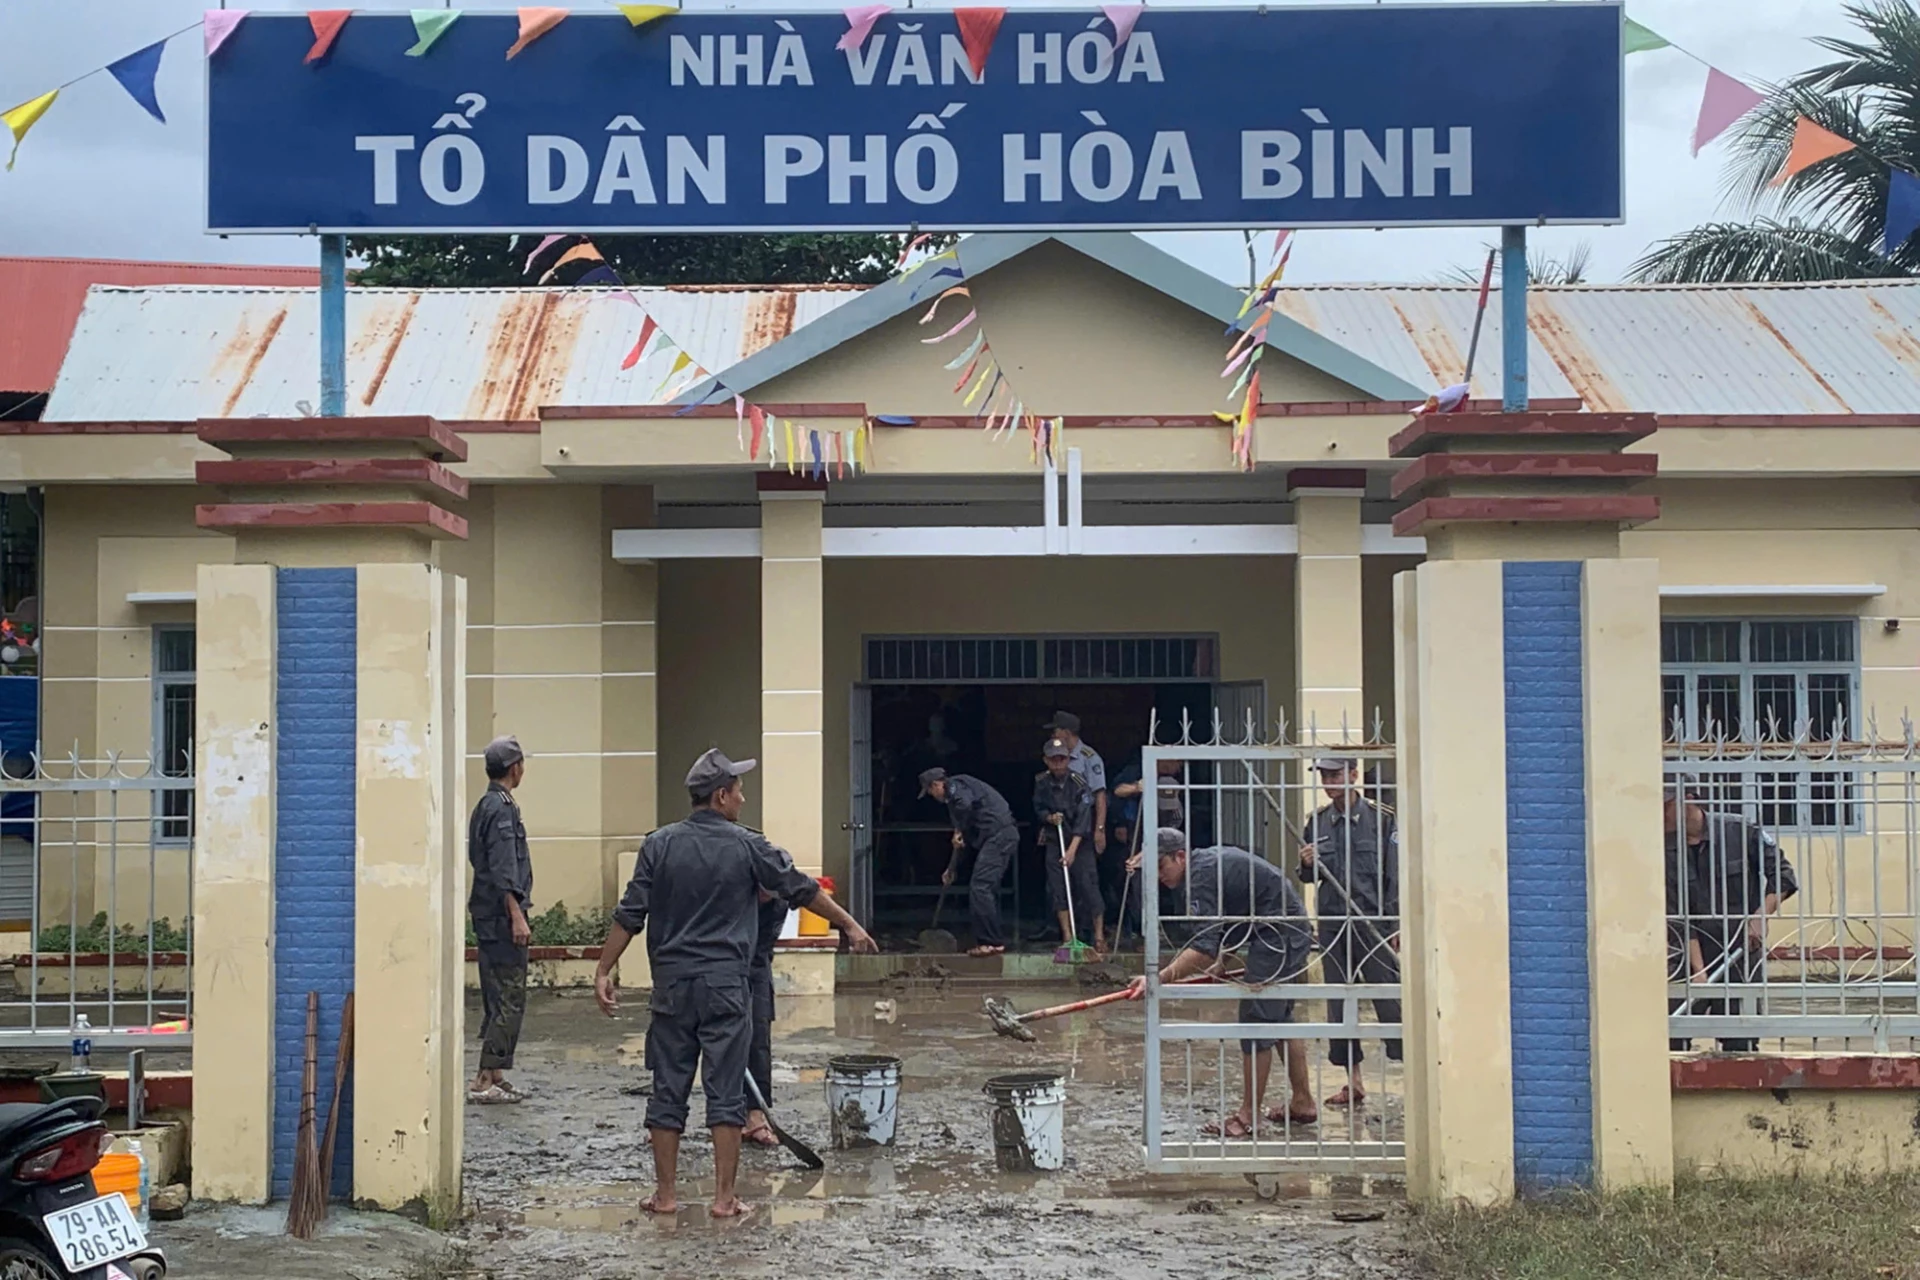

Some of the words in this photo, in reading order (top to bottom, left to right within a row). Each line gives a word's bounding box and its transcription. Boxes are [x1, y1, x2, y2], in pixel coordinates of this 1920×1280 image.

[670, 20, 814, 86] NHÀ
[1018, 17, 1165, 84] HÓA
[355, 92, 487, 205] TỔ
[527, 115, 726, 204] DÂN
[764, 103, 967, 204] PHỐ
[1003, 110, 1203, 202] HÒA
[1241, 108, 1473, 200] BÌNH
[58, 1201, 121, 1239] 79-AA
[66, 1225, 138, 1265] 286.54
